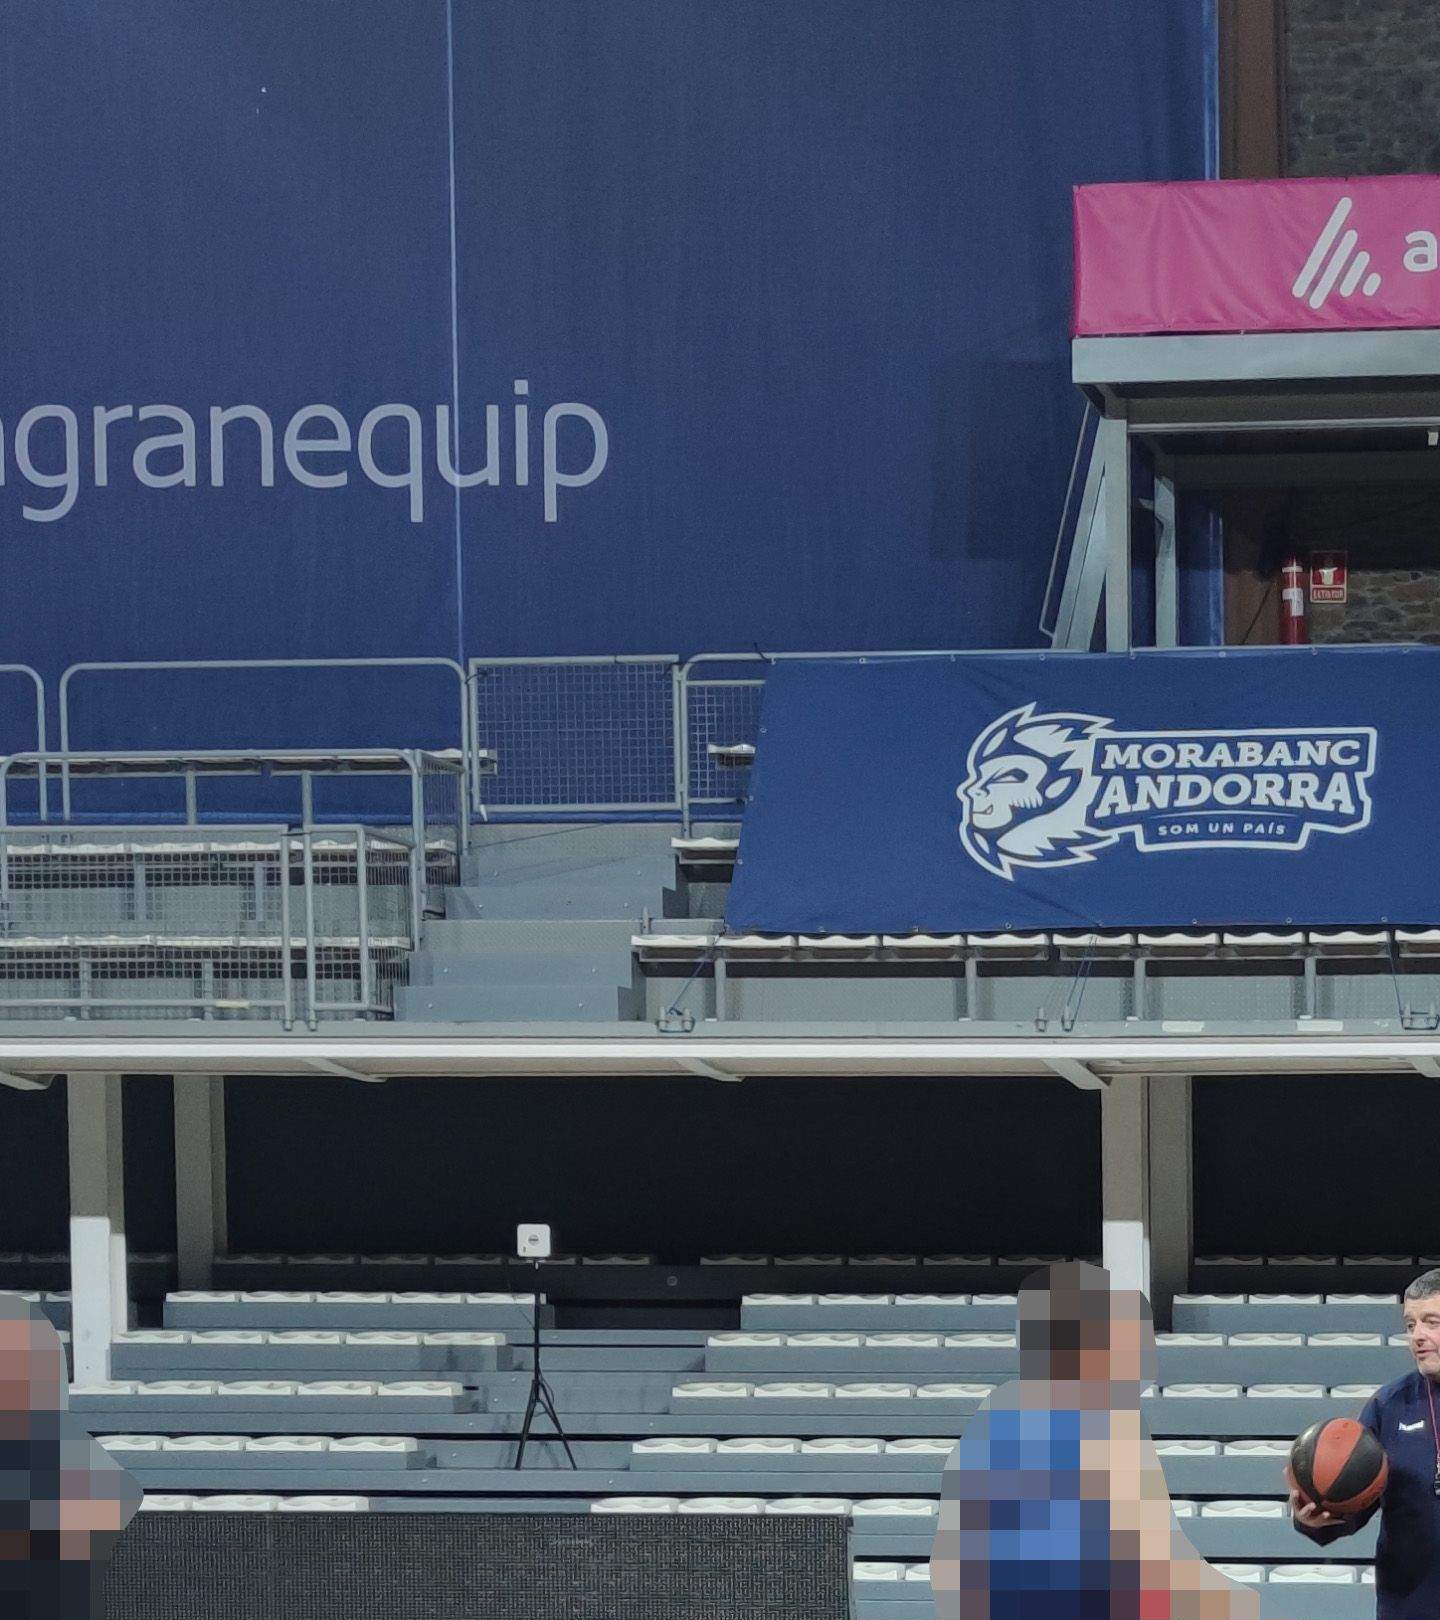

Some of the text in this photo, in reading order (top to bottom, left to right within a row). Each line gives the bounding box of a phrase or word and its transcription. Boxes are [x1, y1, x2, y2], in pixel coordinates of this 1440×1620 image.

[1100, 738, 1361, 771] MORABANC
[1093, 771, 1356, 819] ANDORRA
[1157, 821, 1286, 836] SOM UN PAÍS
